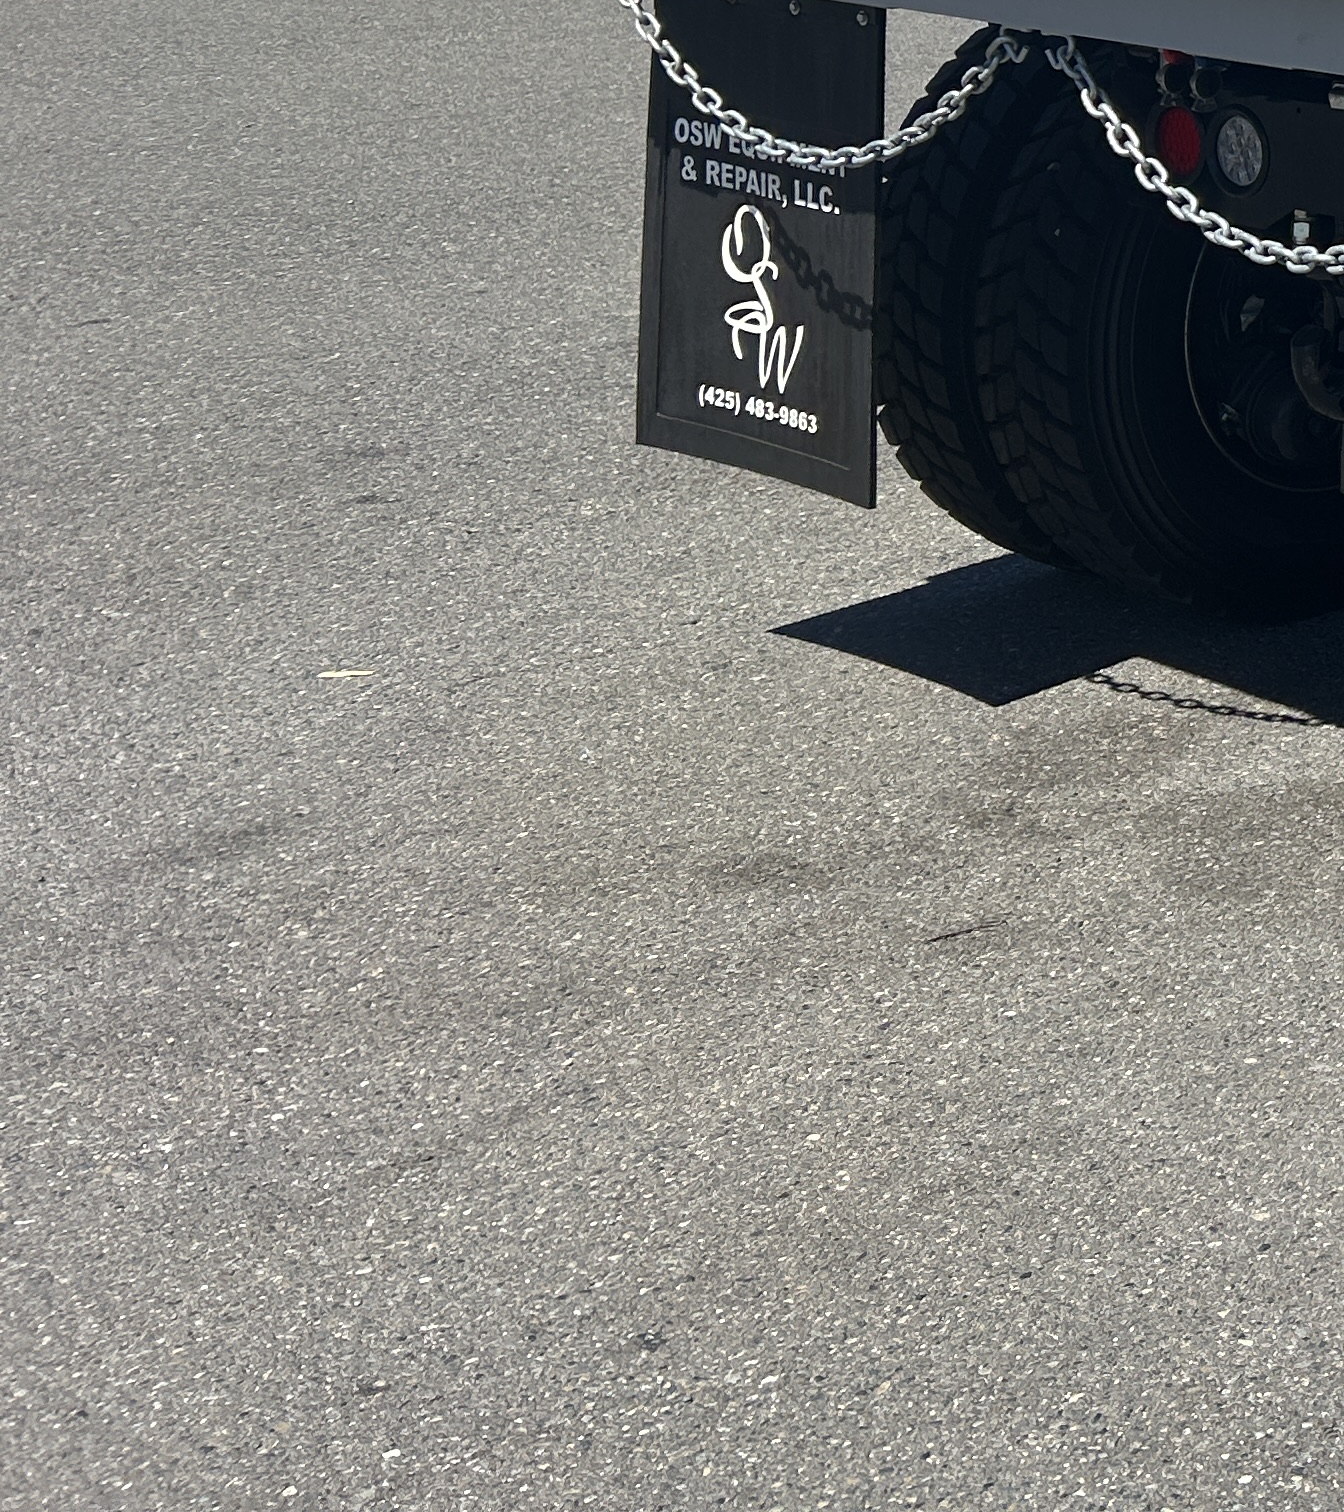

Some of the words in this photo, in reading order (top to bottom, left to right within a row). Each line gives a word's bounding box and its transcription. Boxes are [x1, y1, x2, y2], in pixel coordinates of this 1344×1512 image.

[674, 117, 723, 150] OSW
[681, 155, 698, 182] &
[705, 159, 788, 209] REPAIR,
[793, 178, 841, 215] LLC.
[698, 384, 741, 416] (425)
[744, 396, 818, 434] 483-9863
